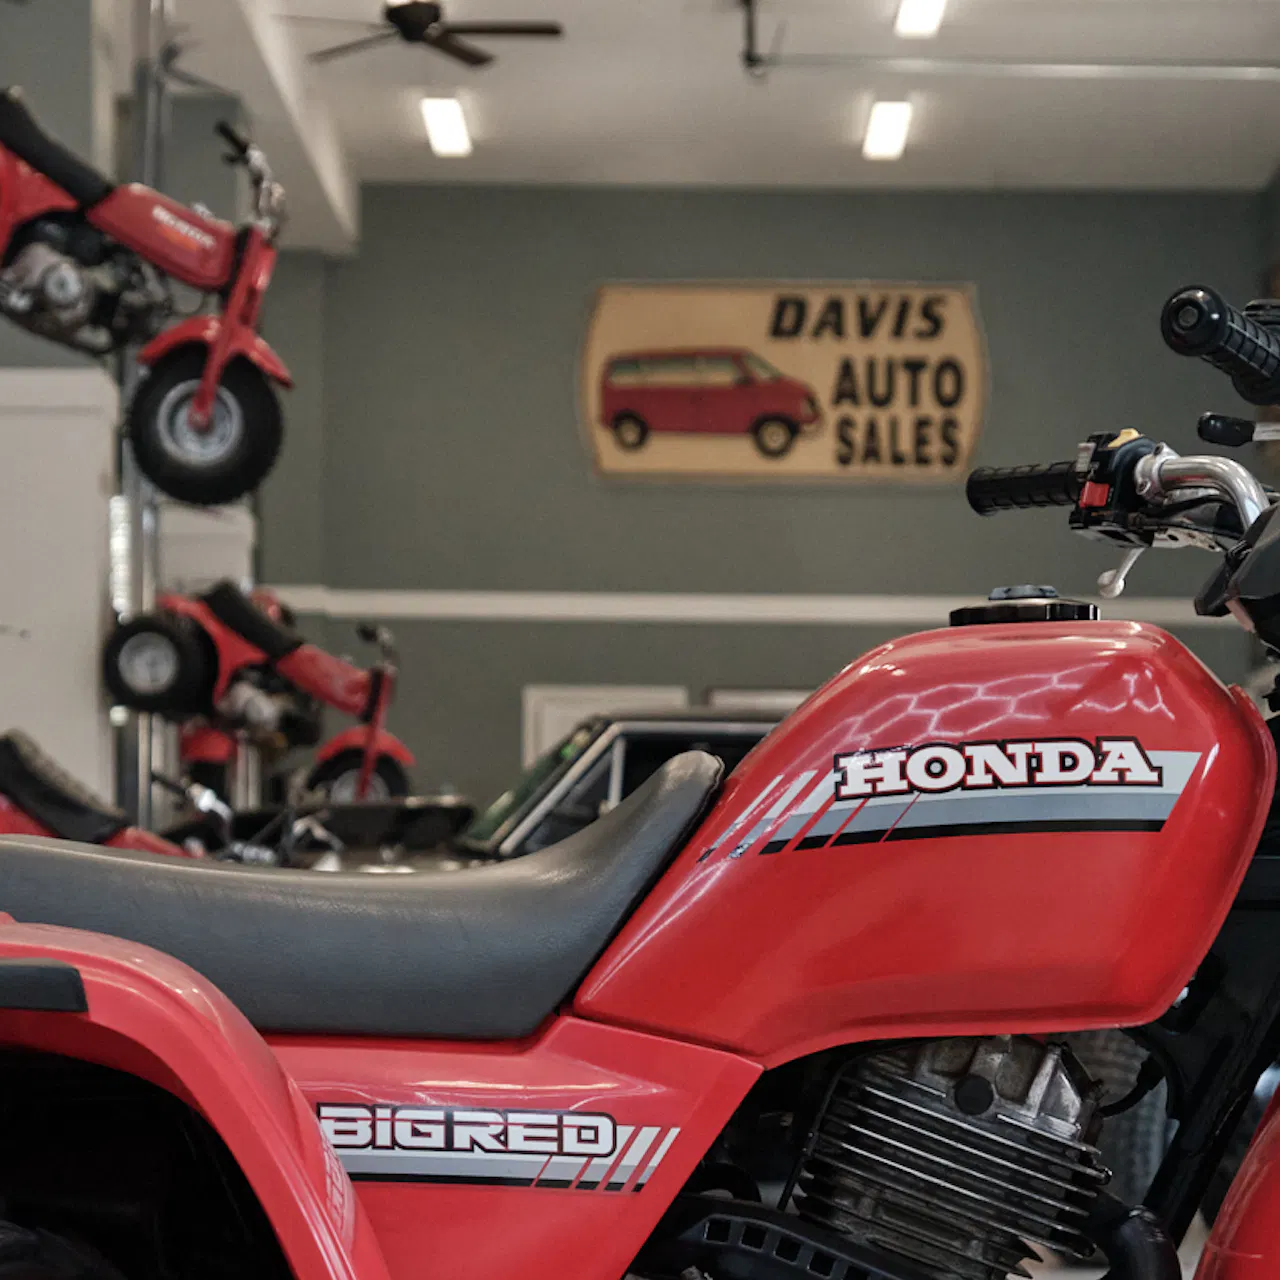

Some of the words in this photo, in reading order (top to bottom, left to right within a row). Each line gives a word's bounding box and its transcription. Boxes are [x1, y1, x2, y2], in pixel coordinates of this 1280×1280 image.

[771, 293, 947, 339] DAVIS
[834, 357, 964, 408] AUTO
[835, 416, 961, 467] SALES
[834, 736, 1163, 800] HONDA
